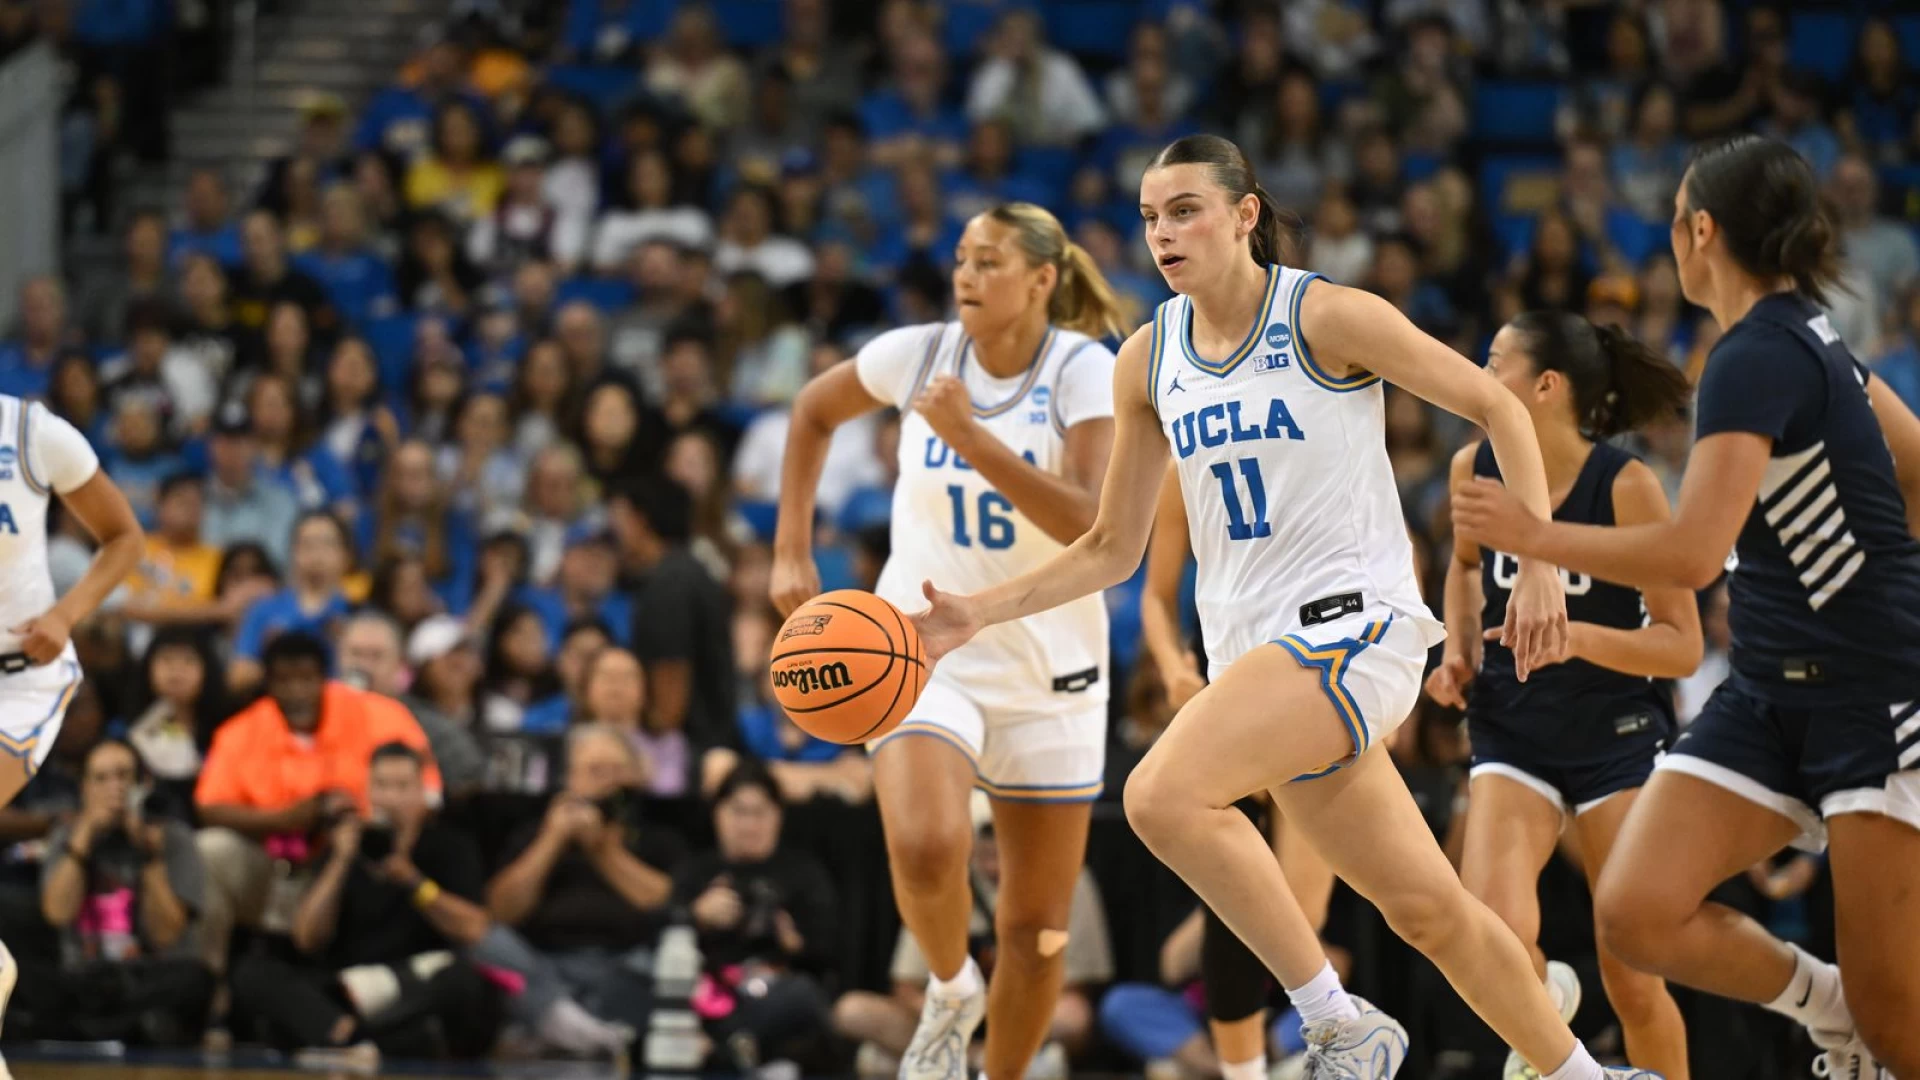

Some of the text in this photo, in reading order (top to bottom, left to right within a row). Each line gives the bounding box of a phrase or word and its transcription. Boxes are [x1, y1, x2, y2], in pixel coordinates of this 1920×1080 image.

[1268, 333, 1290, 343] NCAA
[1171, 398, 1306, 460] UCLA
[947, 484, 1016, 550] 16
[1209, 457, 1272, 540] 11
[1345, 598, 1358, 607] 44
[772, 661, 853, 695] Wilson
